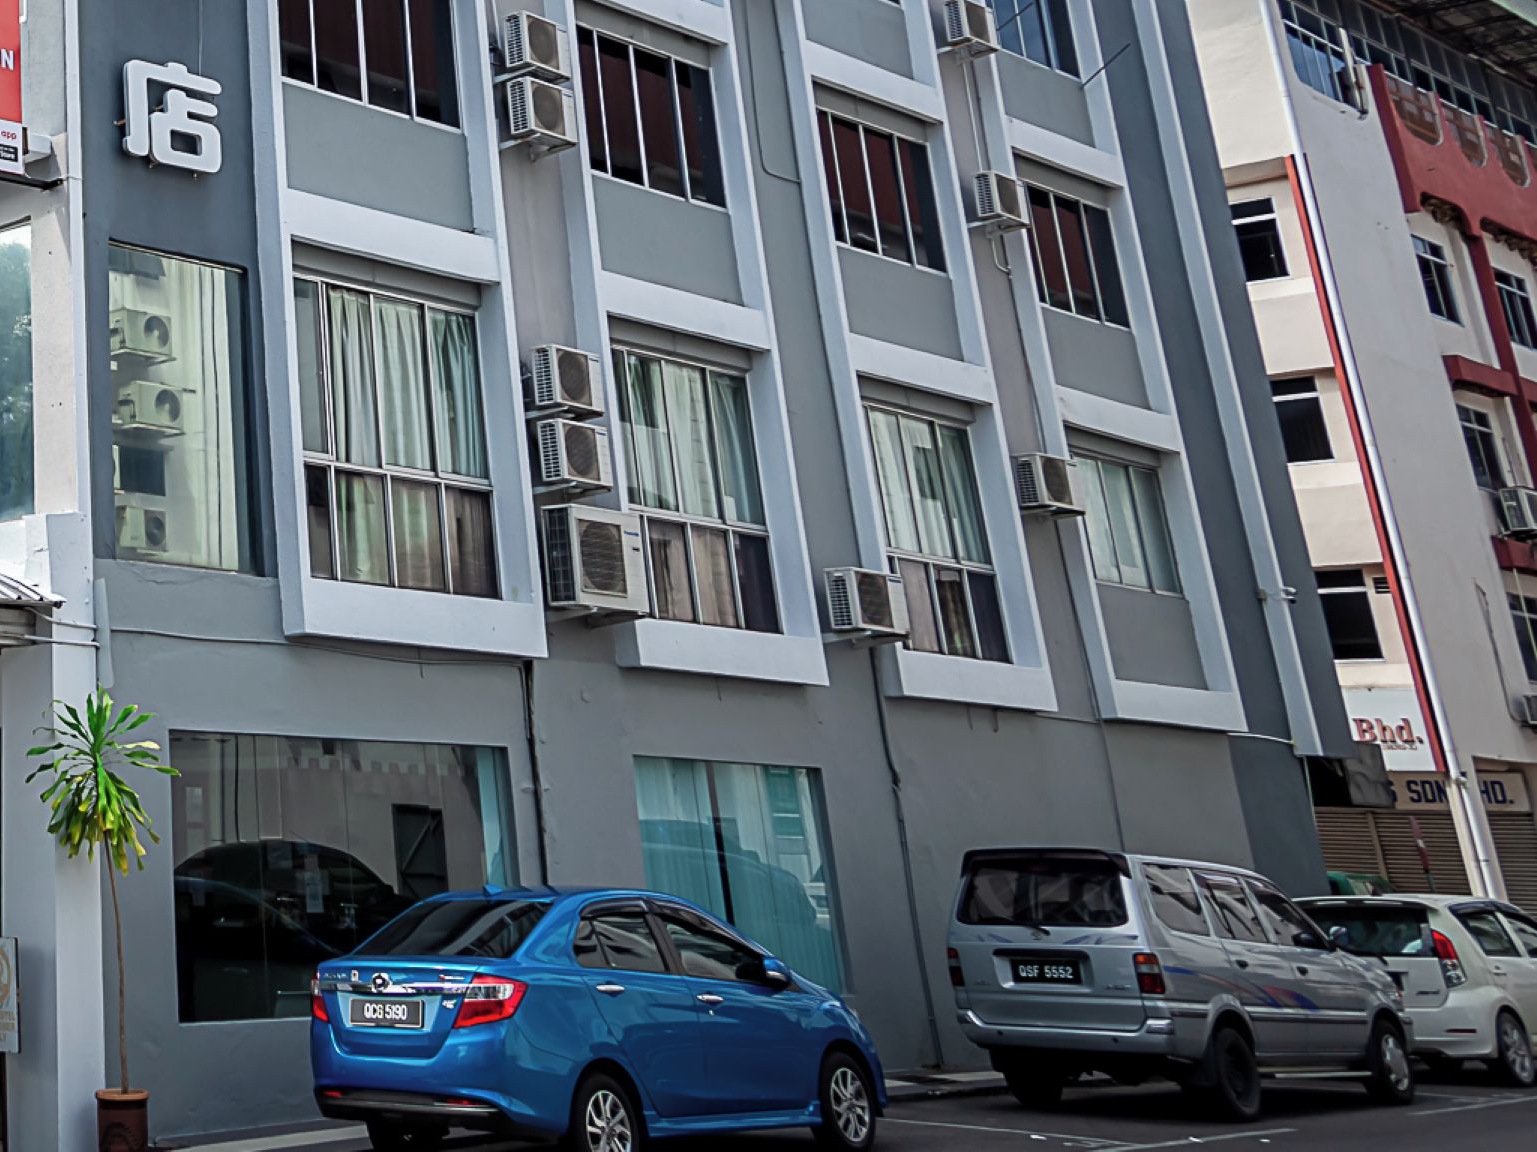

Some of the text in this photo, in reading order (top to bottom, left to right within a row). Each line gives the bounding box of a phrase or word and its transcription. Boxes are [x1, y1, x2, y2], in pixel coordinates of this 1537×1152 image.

[1, 130, 17, 141] app
[1352, 718, 1424, 745] Bhd.
[1044, 965, 1073, 979] 5552
[363, 1002, 407, 1020] QCG 5190
